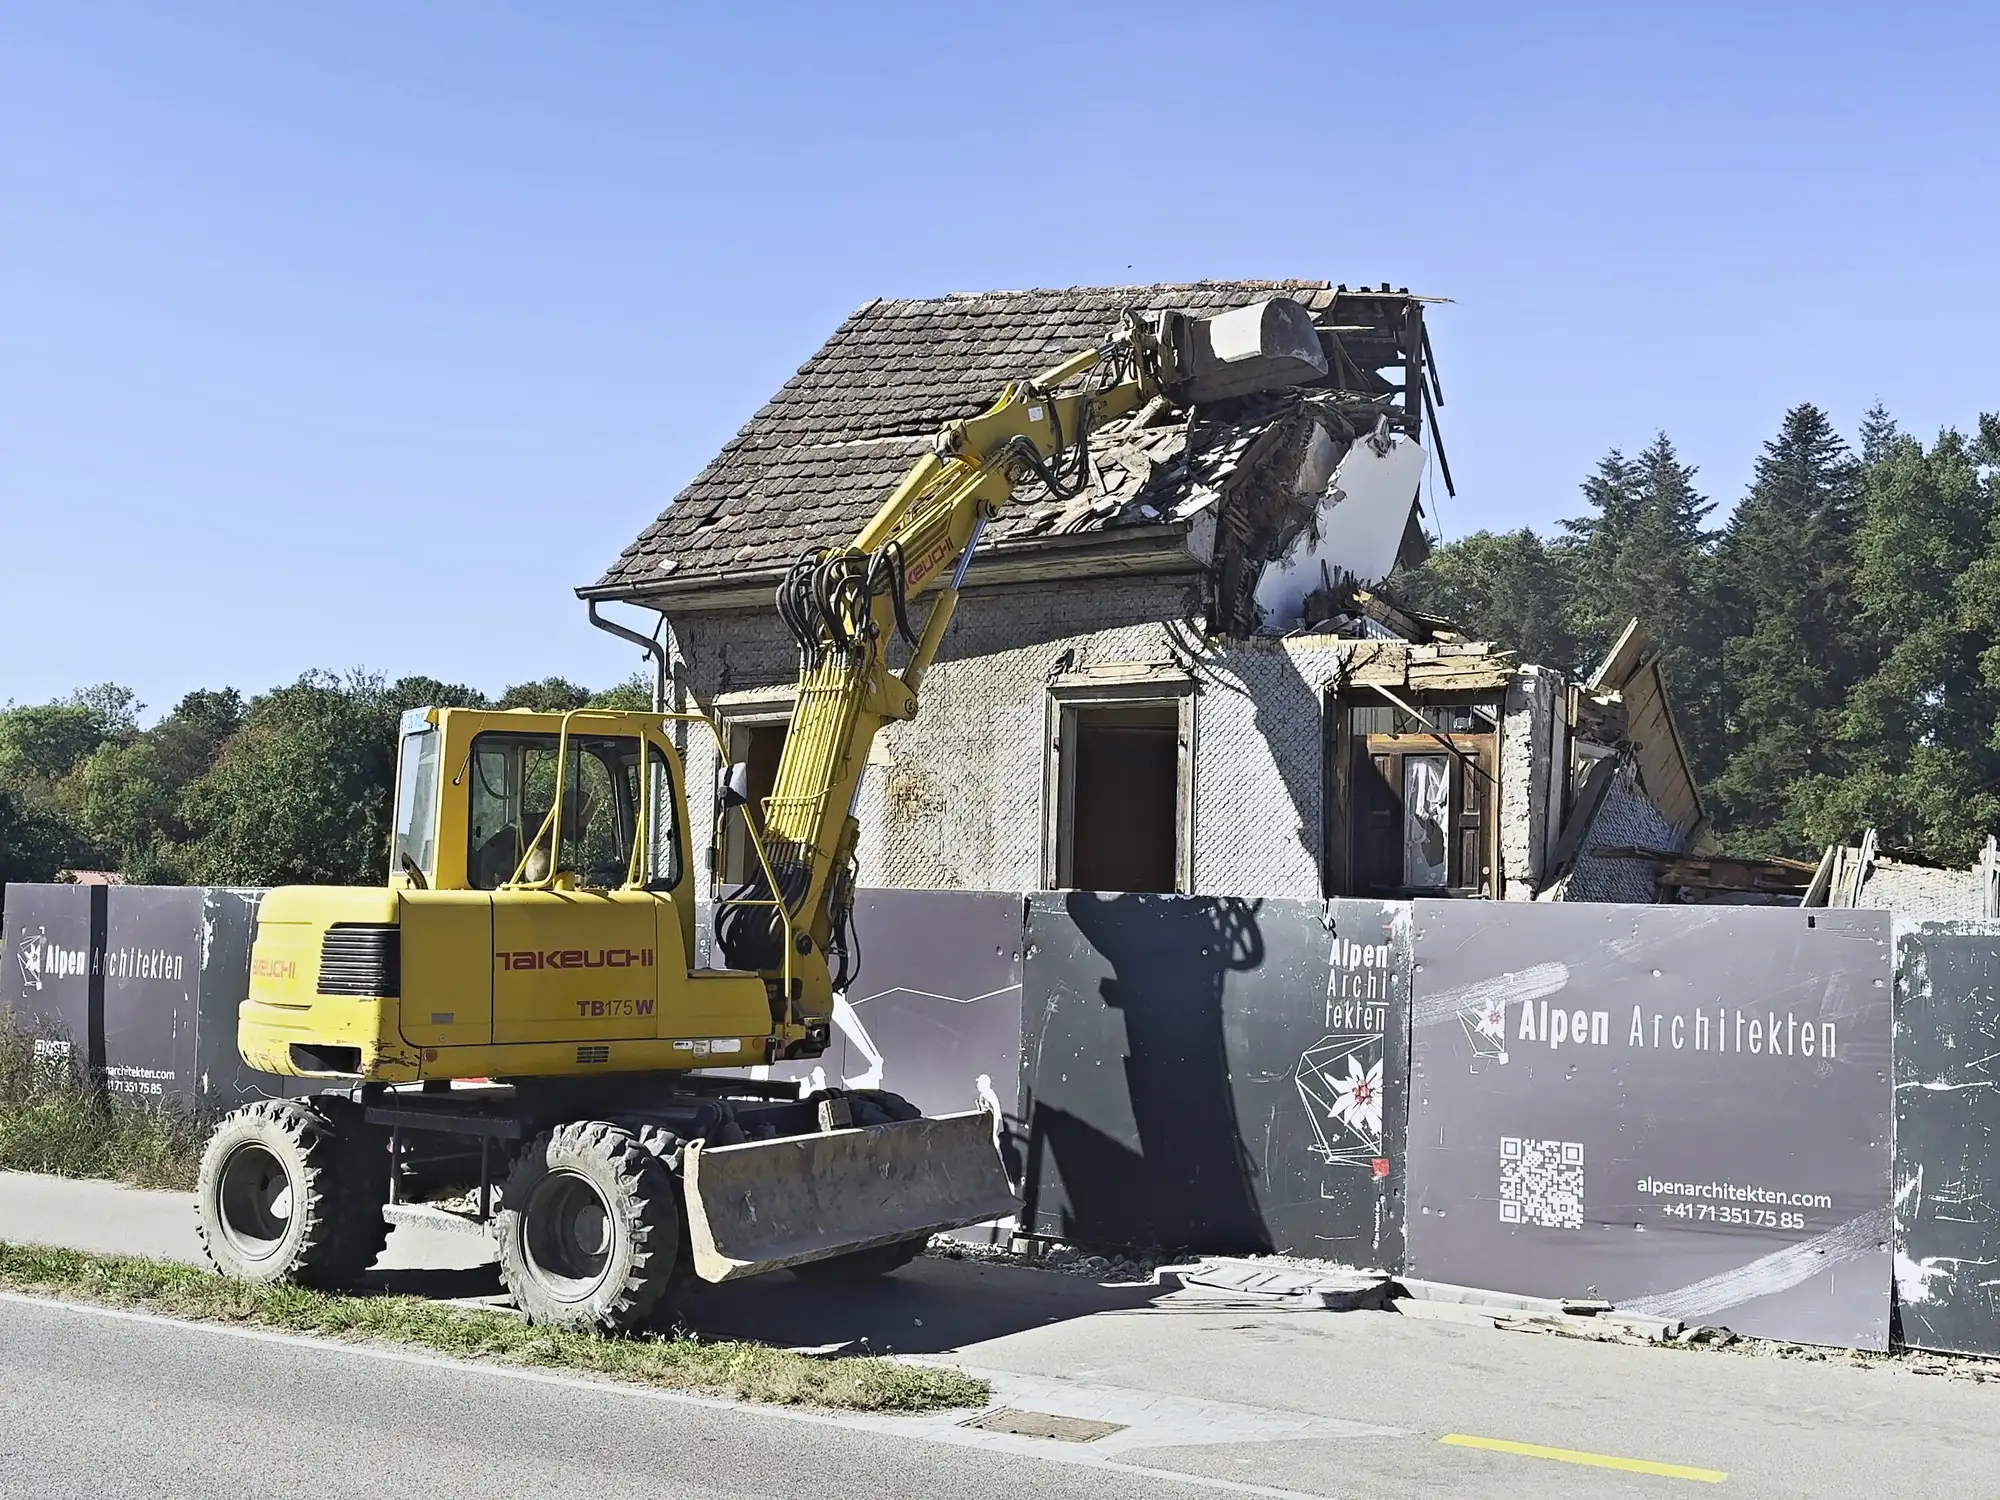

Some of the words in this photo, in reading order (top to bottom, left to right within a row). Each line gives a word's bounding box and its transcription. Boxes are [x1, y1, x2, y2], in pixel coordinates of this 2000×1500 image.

[45, 944, 86, 979] Alpen
[91, 947, 183, 980] Architekten
[1328, 938, 1388, 971] Alpen
[1326, 968, 1387, 999] Archi
[1325, 999, 1386, 1031] tekten
[1518, 1000, 1609, 1050] Alpen
[1628, 1005, 1837, 1058] Architekten
[1637, 1176, 1832, 1209] alpenarchitekten.com
[1663, 1202, 1693, 1219] +41
[1780, 1212, 1805, 1229] 85
